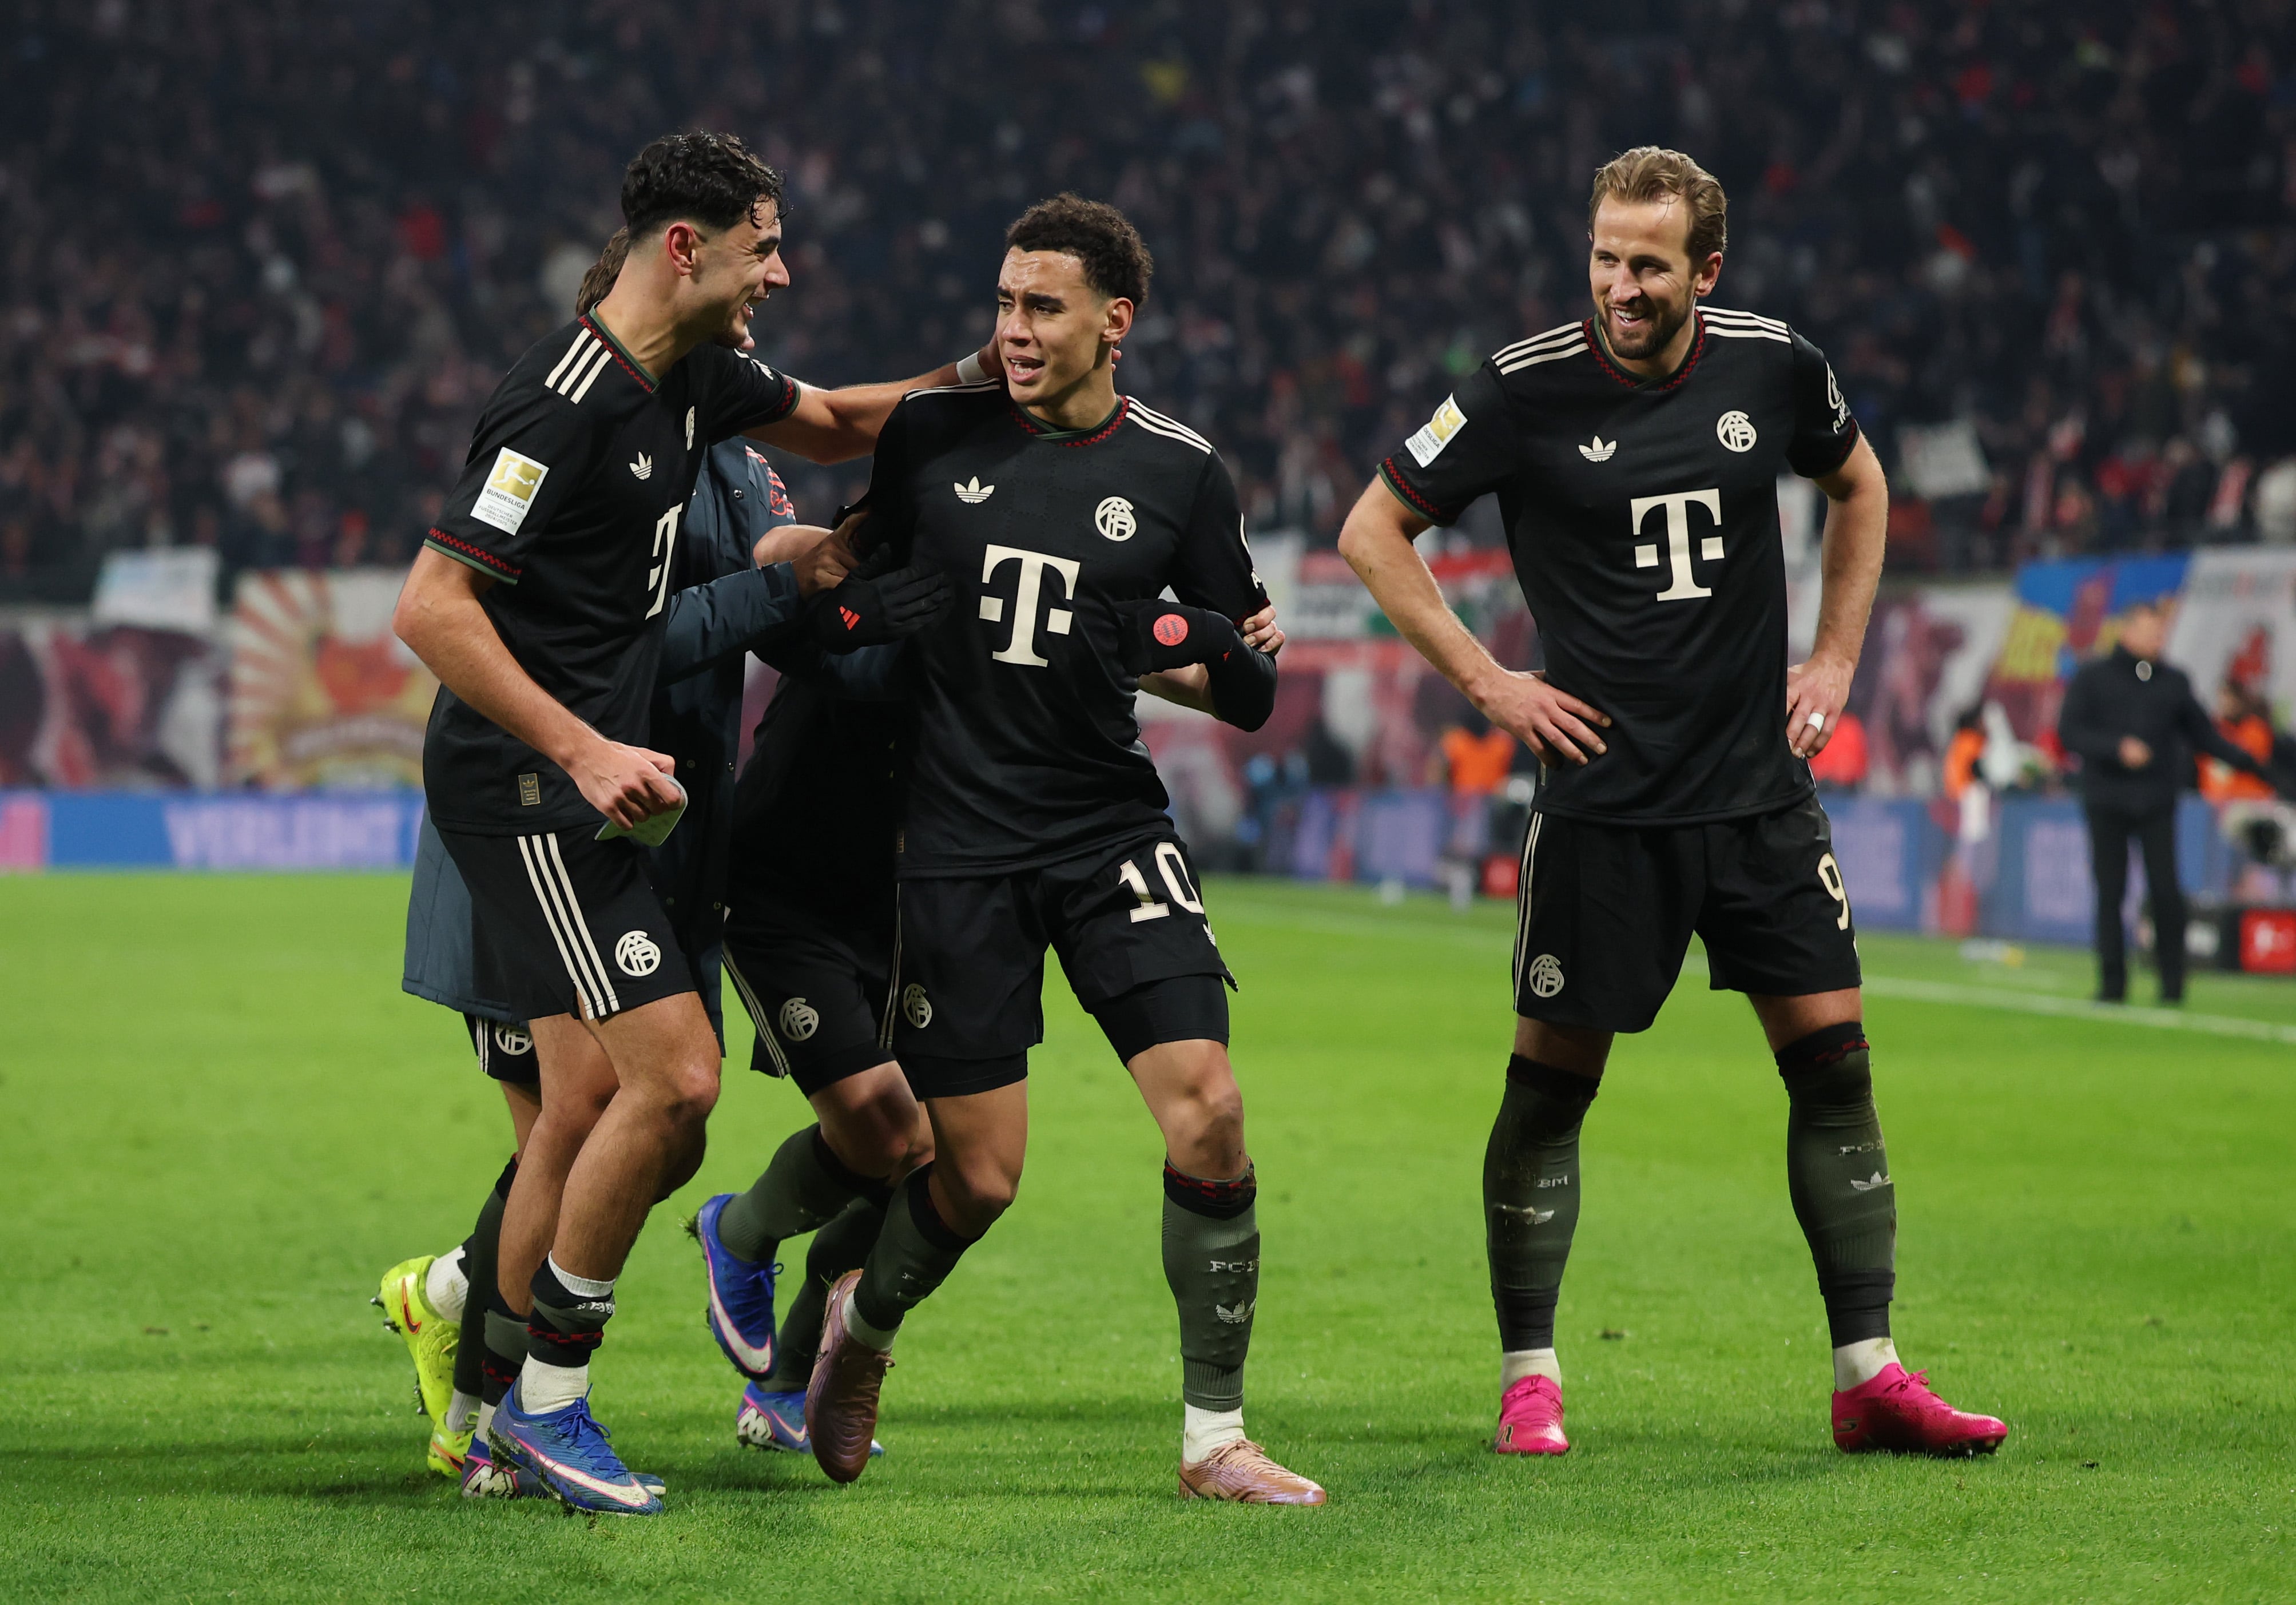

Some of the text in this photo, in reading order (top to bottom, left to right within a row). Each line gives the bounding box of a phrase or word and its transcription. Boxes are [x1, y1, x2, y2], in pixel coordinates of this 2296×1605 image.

[1423, 427, 1440, 448] DESLIGA
[486, 488, 525, 510] BUNDESLIGA
[478, 505, 518, 526] FUSSBALLMEISTER
[484, 513, 508, 526] 2024/2025
[487, 504, 514, 518] DEUTSCHER
[1630, 488, 1725, 602] T
[979, 544, 1081, 668] T
[1118, 841, 1205, 923] 10
[1817, 852, 1849, 931] 9
